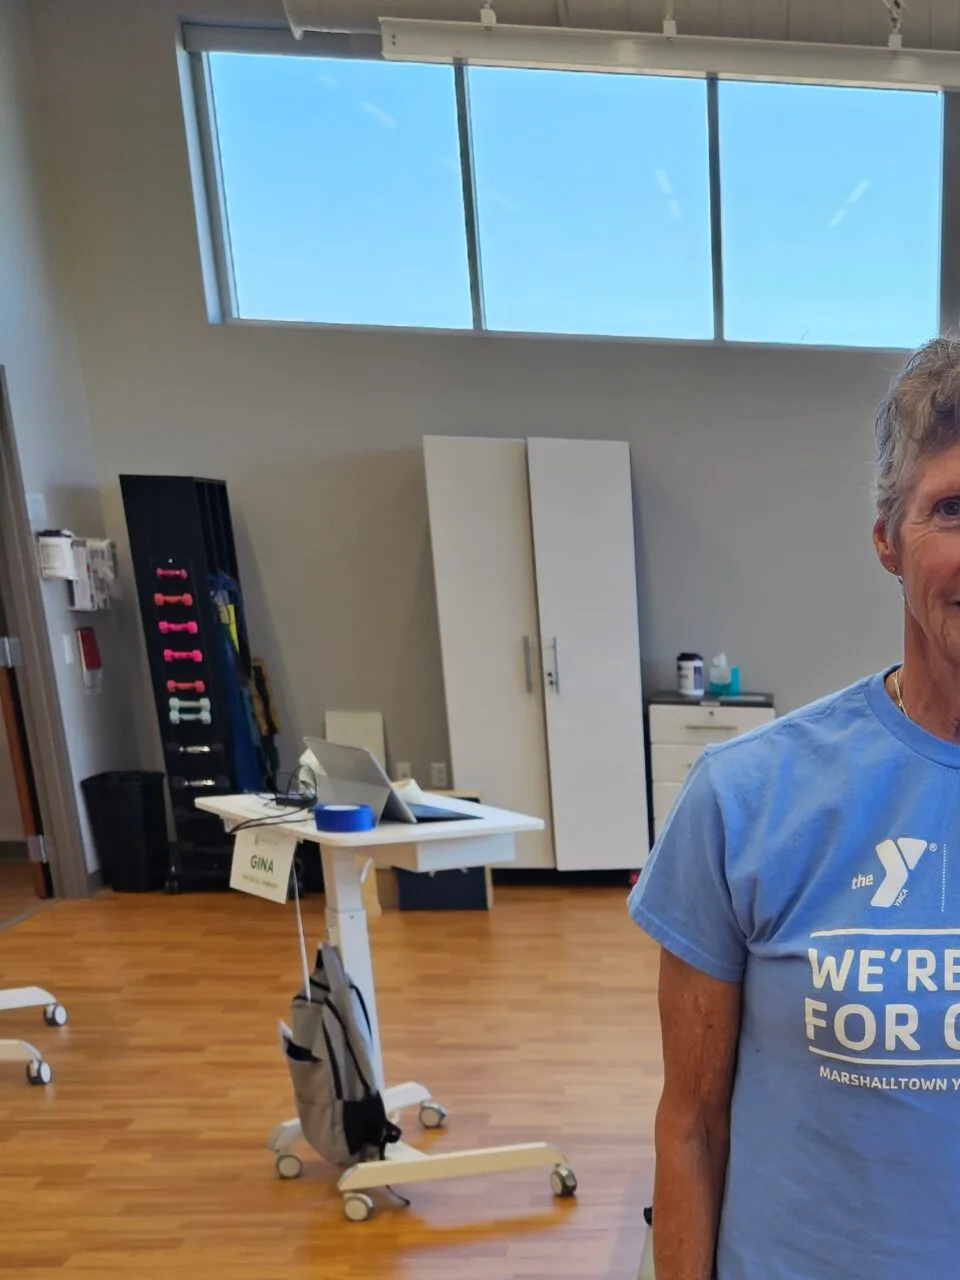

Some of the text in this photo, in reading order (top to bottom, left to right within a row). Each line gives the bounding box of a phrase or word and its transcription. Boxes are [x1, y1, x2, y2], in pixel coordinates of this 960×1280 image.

[250, 854, 274, 875] GINA
[851, 874, 874, 890] the
[894, 888, 909, 907] YMCA
[804, 997, 921, 1051] FOR
[819, 1065, 948, 1091] MARSHALLTOWN
